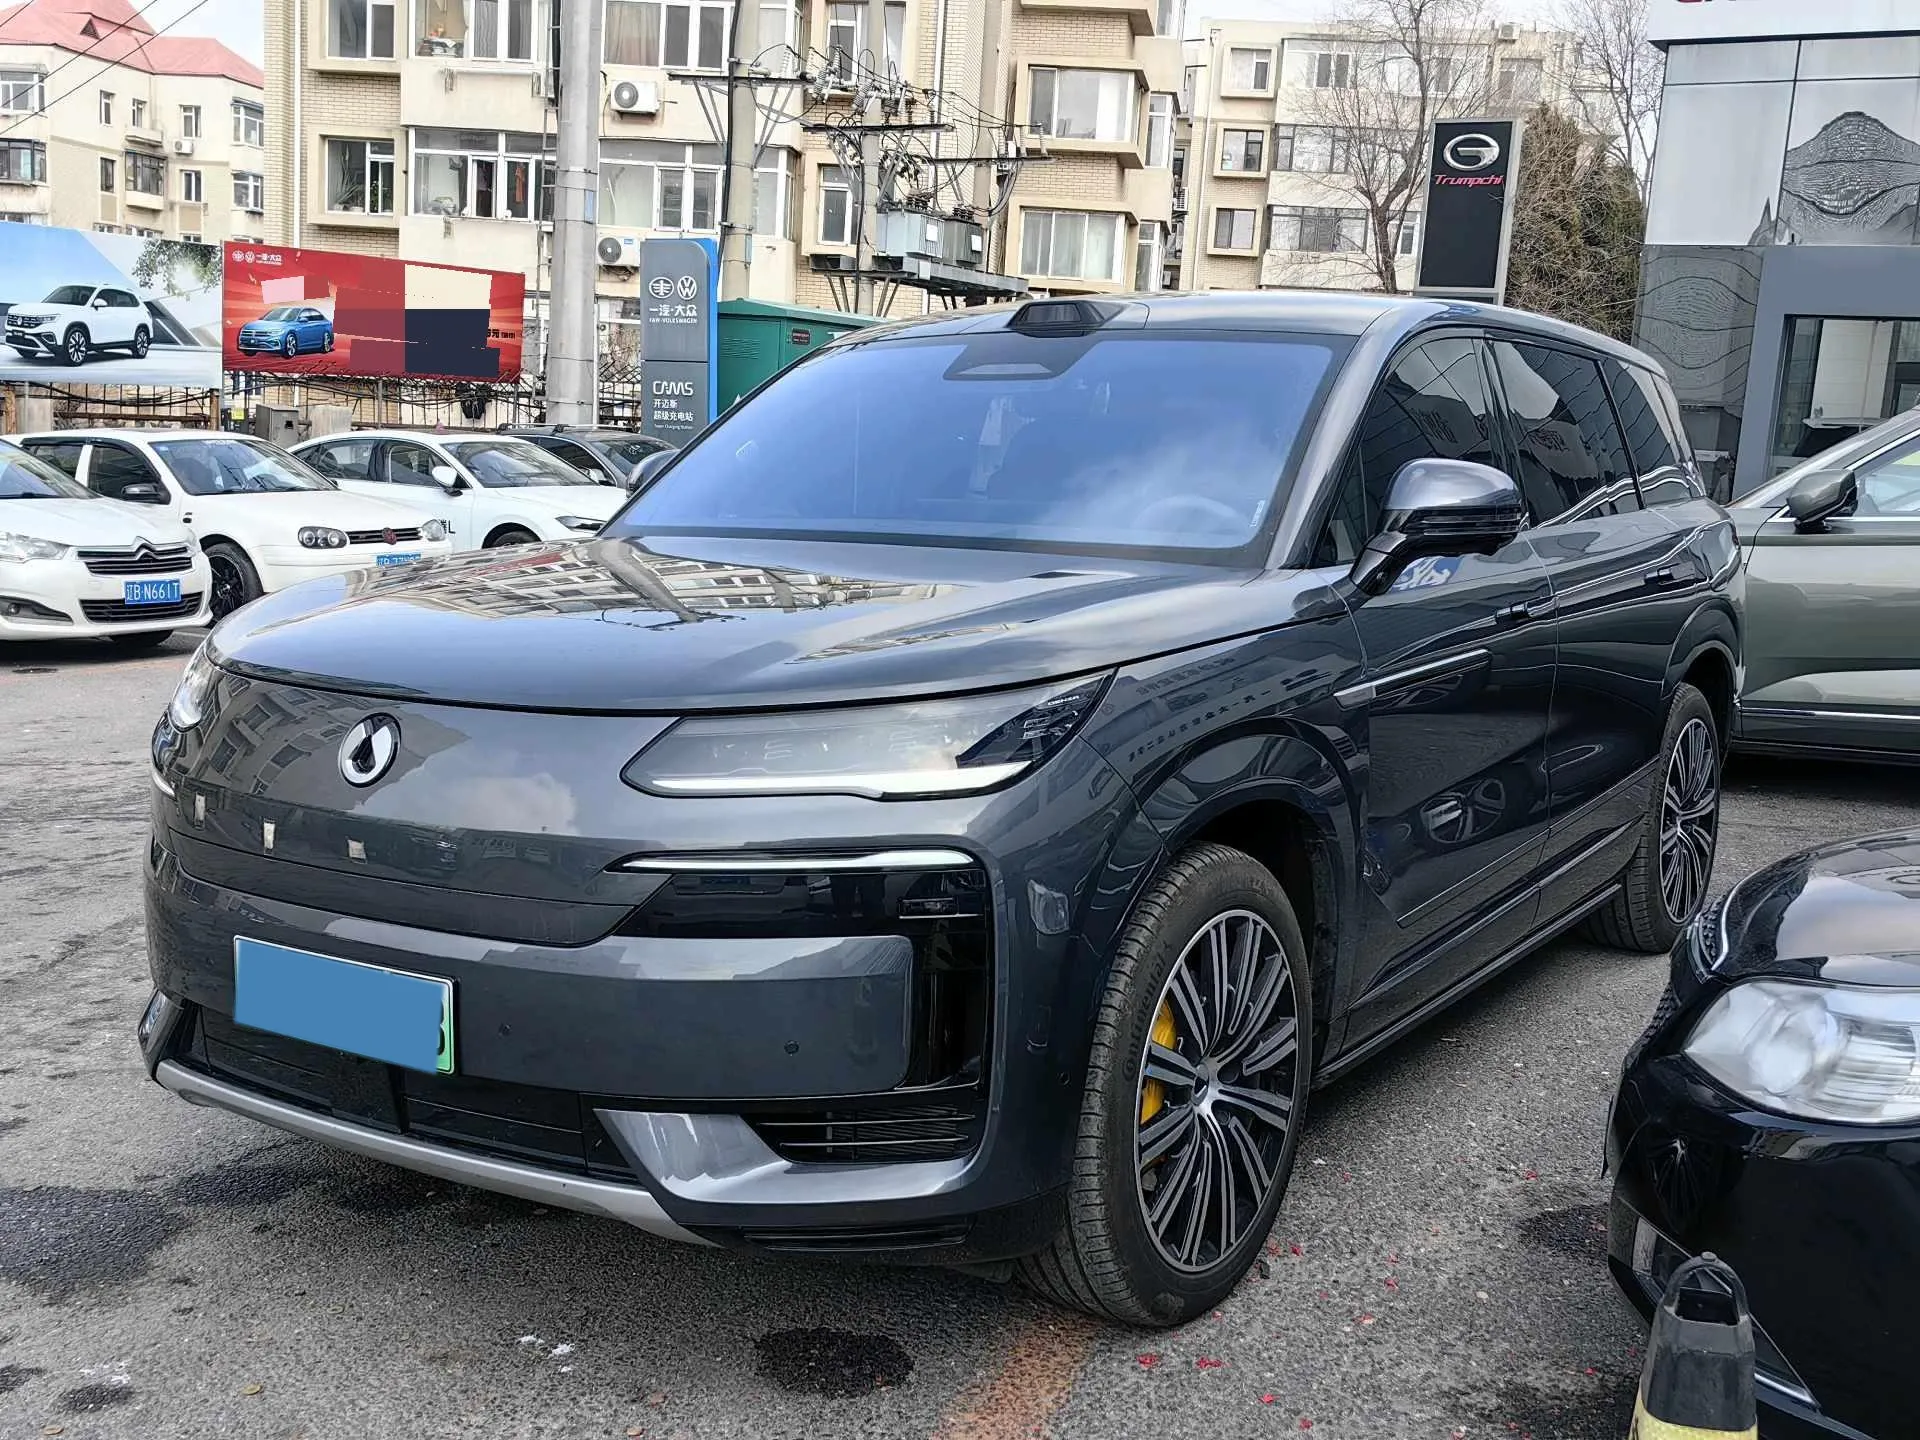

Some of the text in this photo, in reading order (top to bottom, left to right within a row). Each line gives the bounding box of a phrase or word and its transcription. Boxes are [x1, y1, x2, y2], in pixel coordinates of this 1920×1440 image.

[1434, 174, 1504, 188] Trumpchi
[653, 410, 694, 422] 超级充电站
